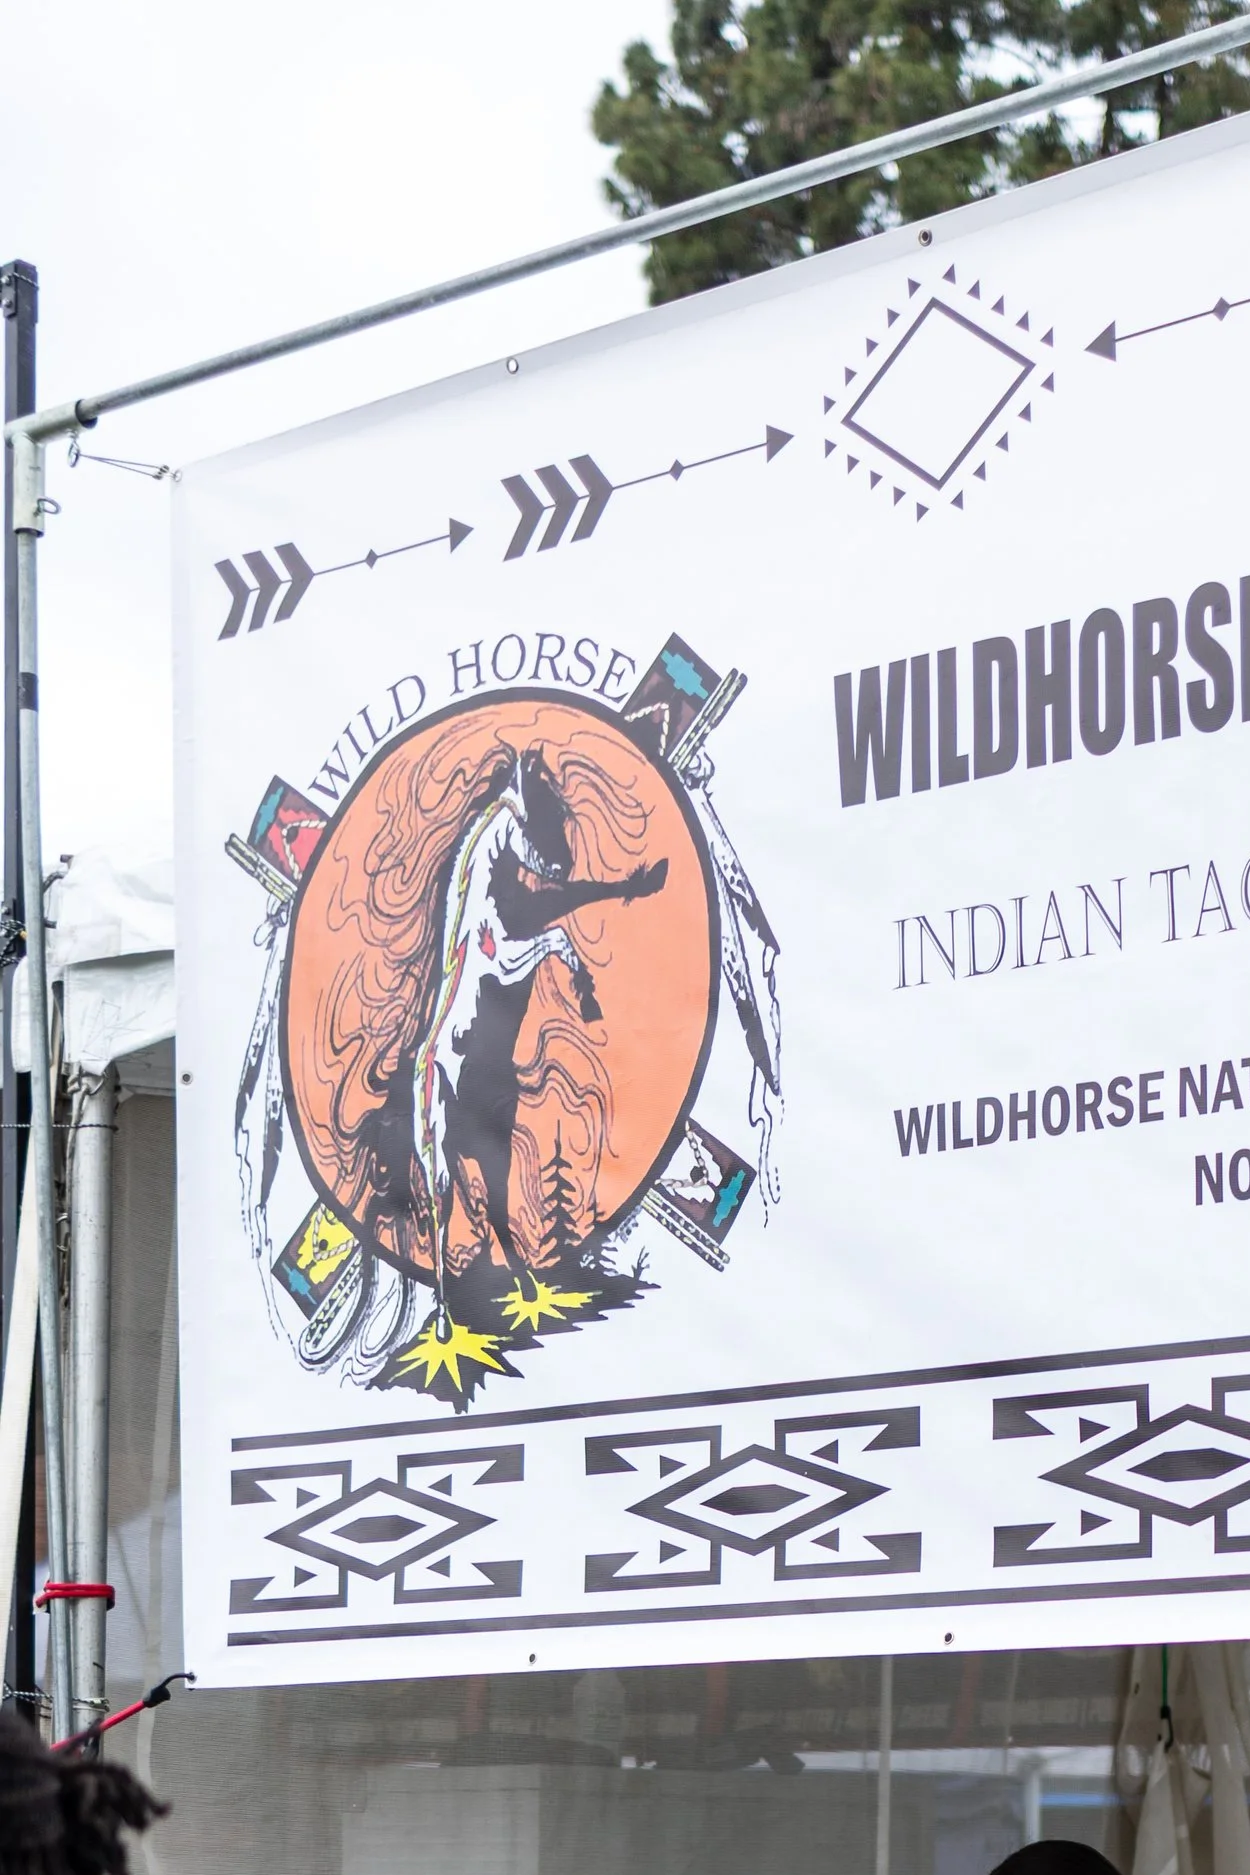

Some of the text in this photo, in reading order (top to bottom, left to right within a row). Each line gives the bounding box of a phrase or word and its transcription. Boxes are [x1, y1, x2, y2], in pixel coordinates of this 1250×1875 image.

[308, 632, 637, 801] WILD HORSE
[892, 877, 1127, 990] INDIAN
[894, 1071, 1165, 1157] WILDHORSE
